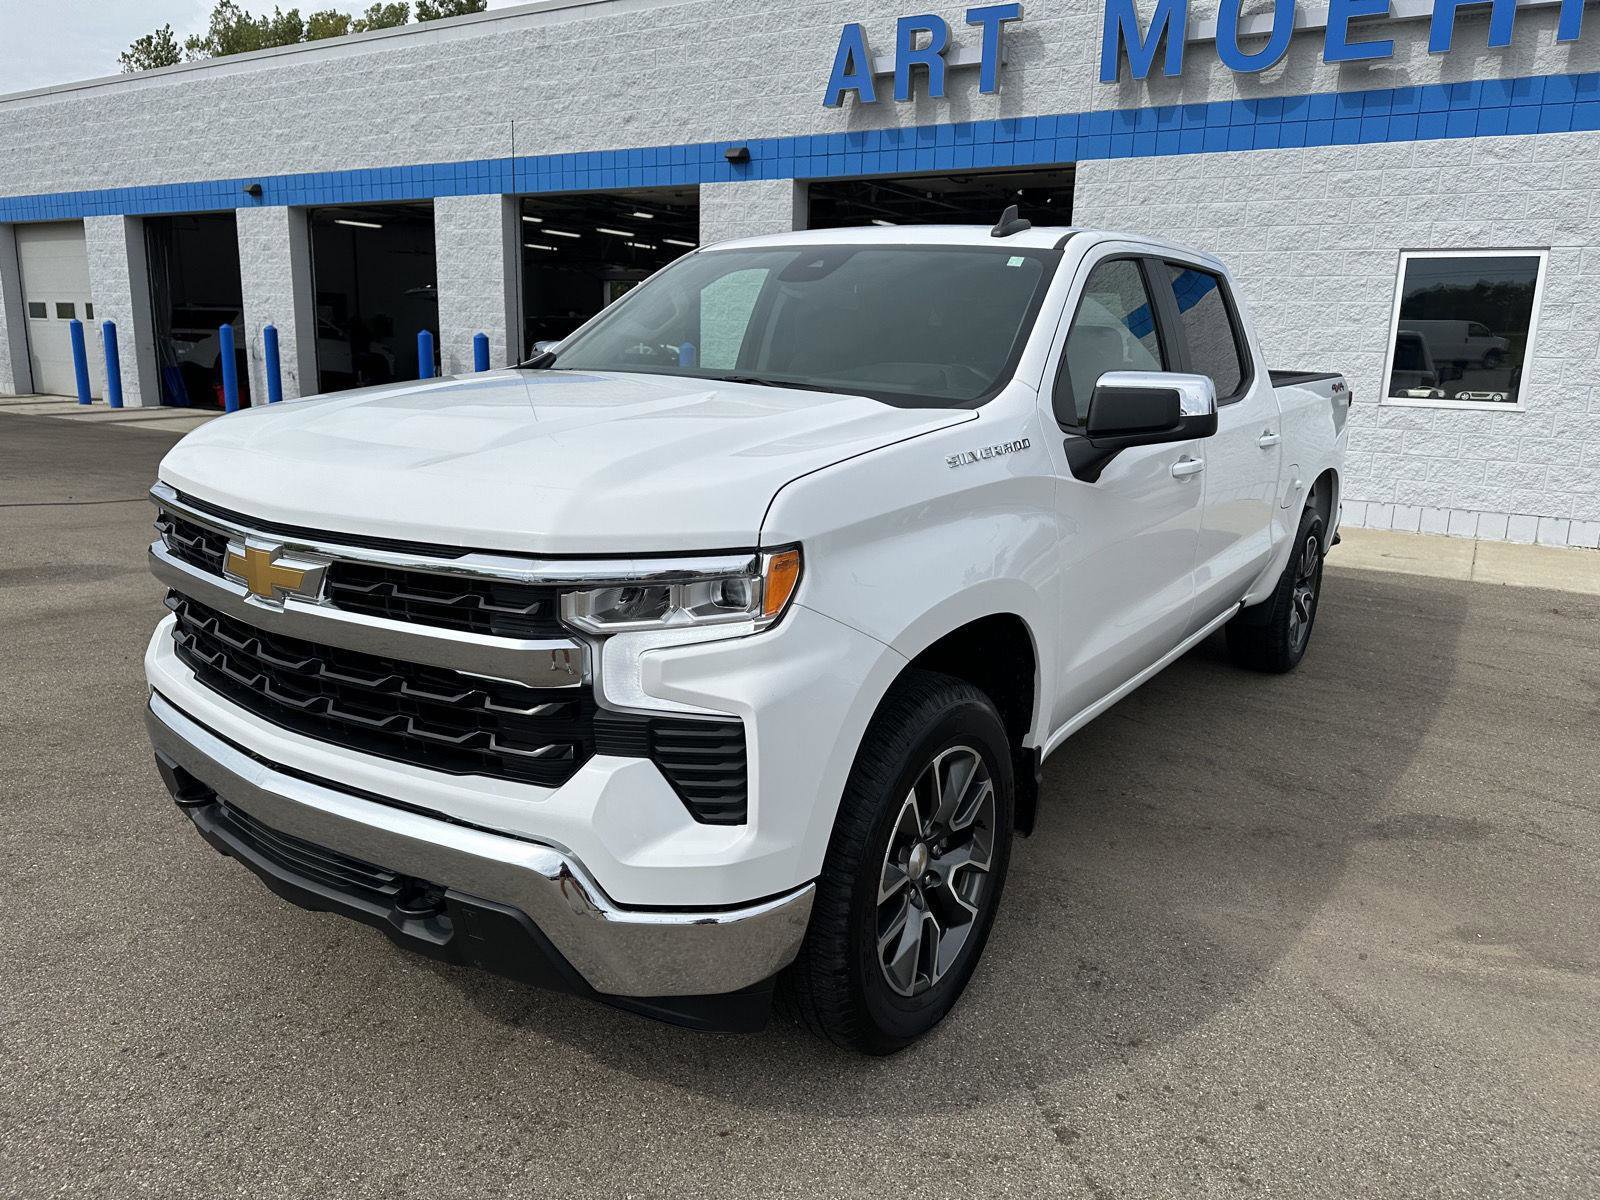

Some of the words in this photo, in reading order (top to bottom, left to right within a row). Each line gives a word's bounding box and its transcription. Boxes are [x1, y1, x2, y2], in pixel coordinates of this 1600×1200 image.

[822, 2, 1024, 107] ART
[1100, 0, 1585, 83] MOEH
[946, 438, 1031, 469] SILVERADO
